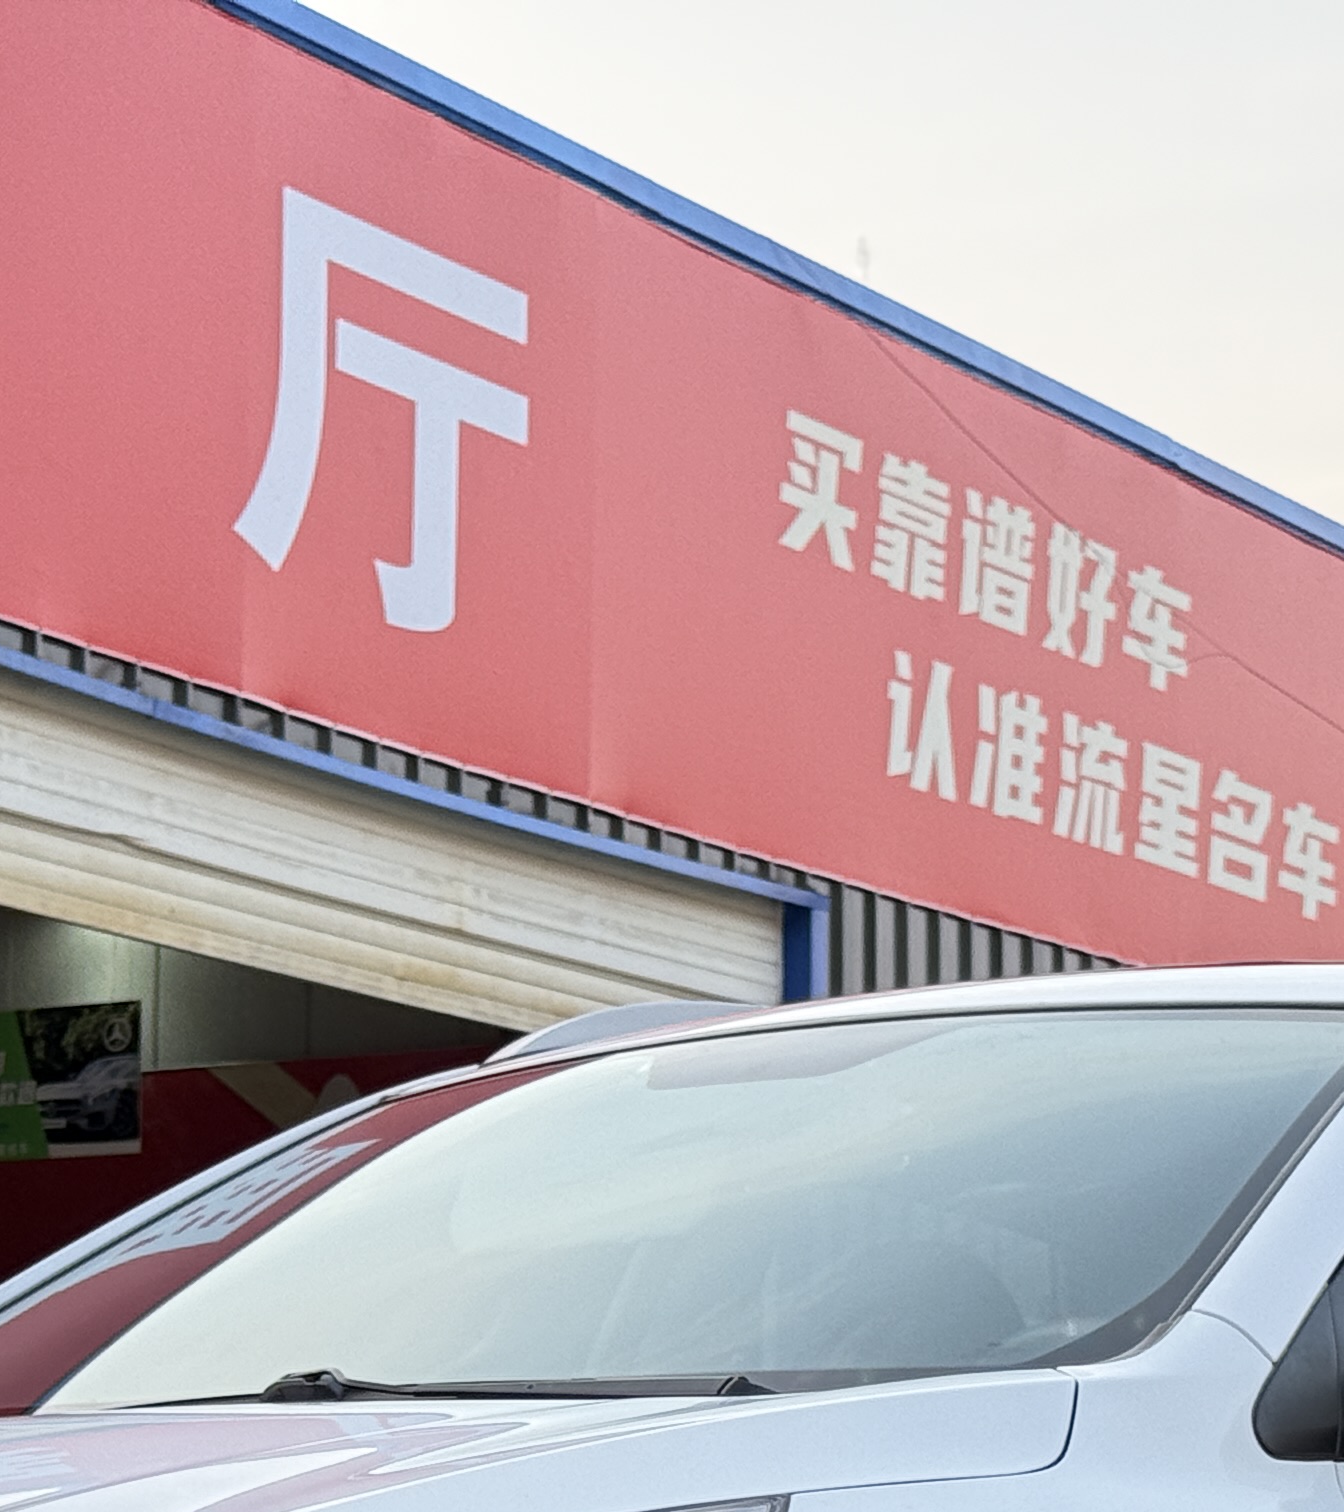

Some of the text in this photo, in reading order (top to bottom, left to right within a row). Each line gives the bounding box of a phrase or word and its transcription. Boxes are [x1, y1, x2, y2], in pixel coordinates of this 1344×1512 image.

[778, 409, 1193, 692] 买靠谱好车
[886, 650, 1341, 922] 认准流星名车
